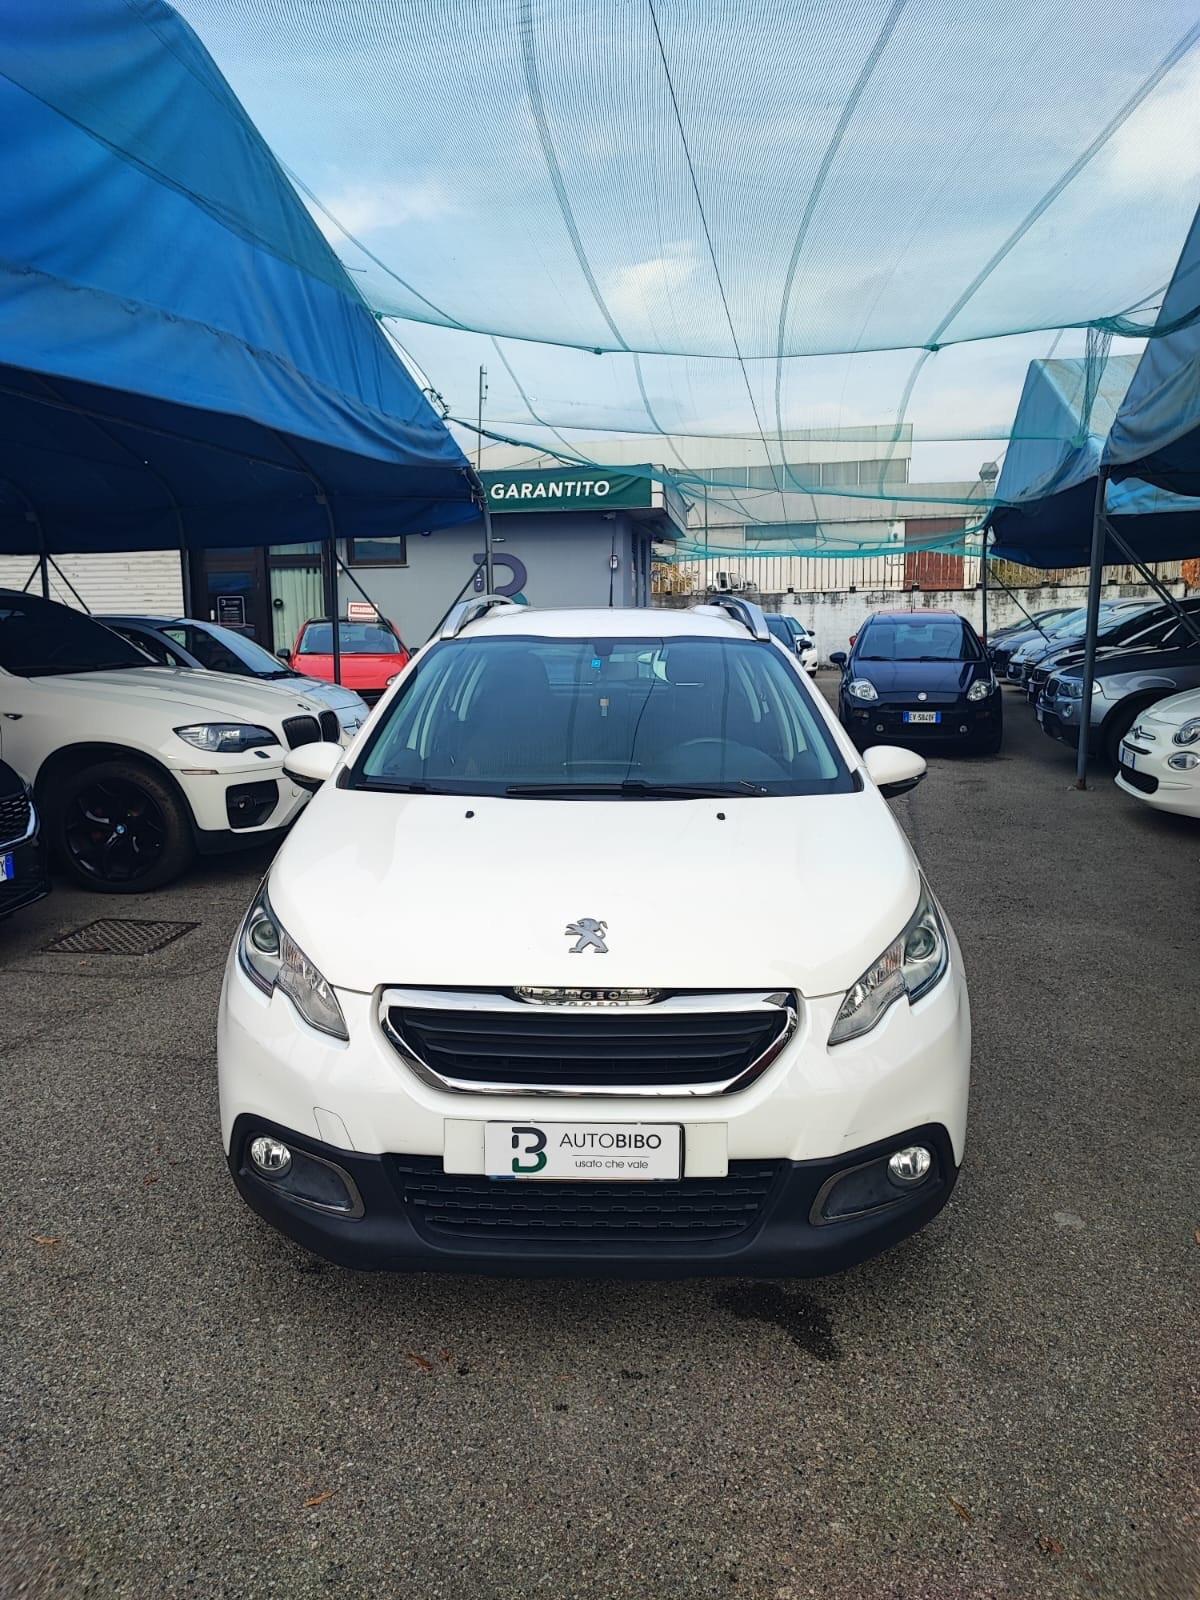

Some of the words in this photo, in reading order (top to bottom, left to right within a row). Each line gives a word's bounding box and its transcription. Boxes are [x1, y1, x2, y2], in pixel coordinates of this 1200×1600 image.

[490, 480, 610, 499] GARANTITO
[559, 1133, 662, 1149] AUTOBIBO
[575, 1159, 603, 1168] usato
[605, 1159, 624, 1169] che
[627, 1160, 649, 1169] vale
